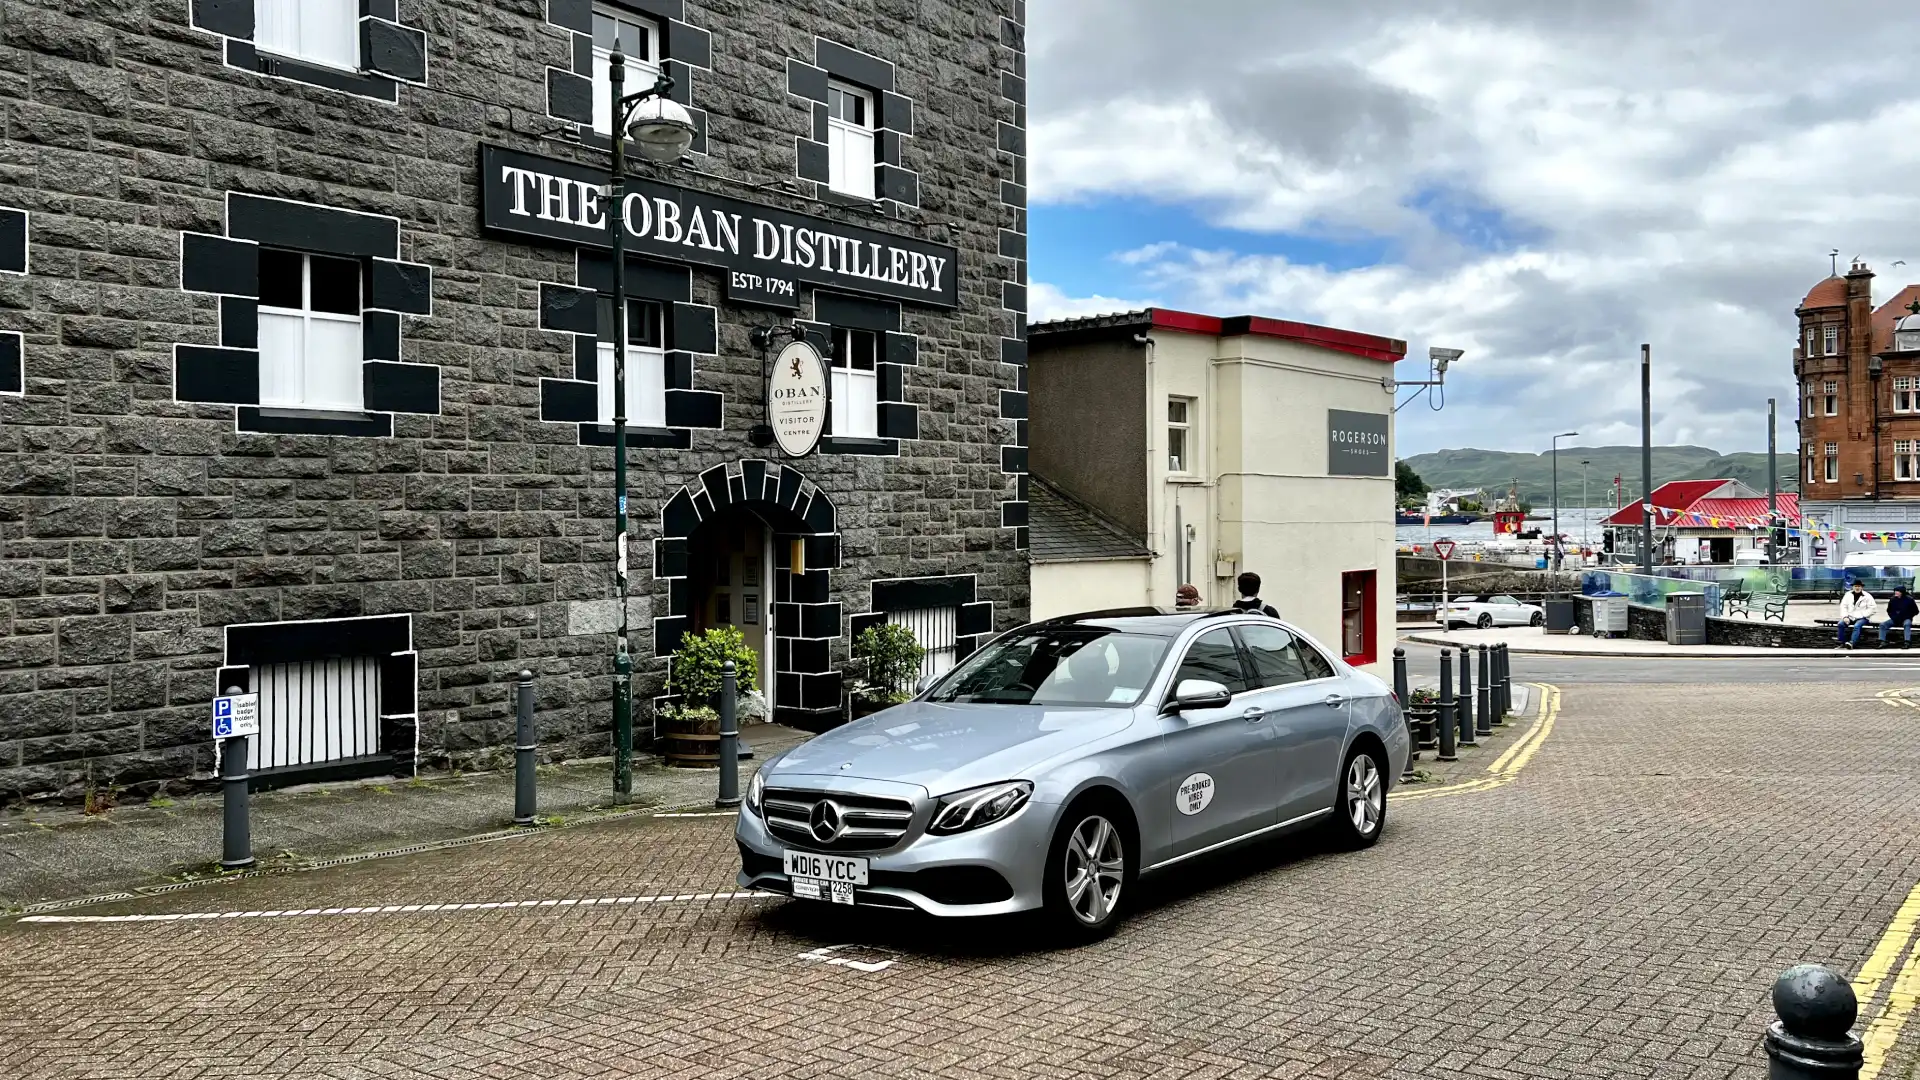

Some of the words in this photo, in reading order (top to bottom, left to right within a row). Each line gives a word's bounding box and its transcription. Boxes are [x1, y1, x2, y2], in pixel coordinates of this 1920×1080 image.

[502, 166, 606, 230] THE
[622, 192, 742, 254] OBAN
[752, 218, 947, 292] DISTILLERY
[766, 277, 795, 297] 1794
[774, 386, 820, 398] OBAN
[779, 416, 815, 425] VISITOR
[1332, 430, 1386, 445] ROGERSON
[1350, 448, 1369, 456] SHOES
[1180, 779, 1211, 796] PRE-BOOKED
[1189, 790, 1203, 803] HIRES
[791, 854, 821, 877] WD16
[825, 859, 856, 880] YCC
[832, 881, 853, 895] 2258
